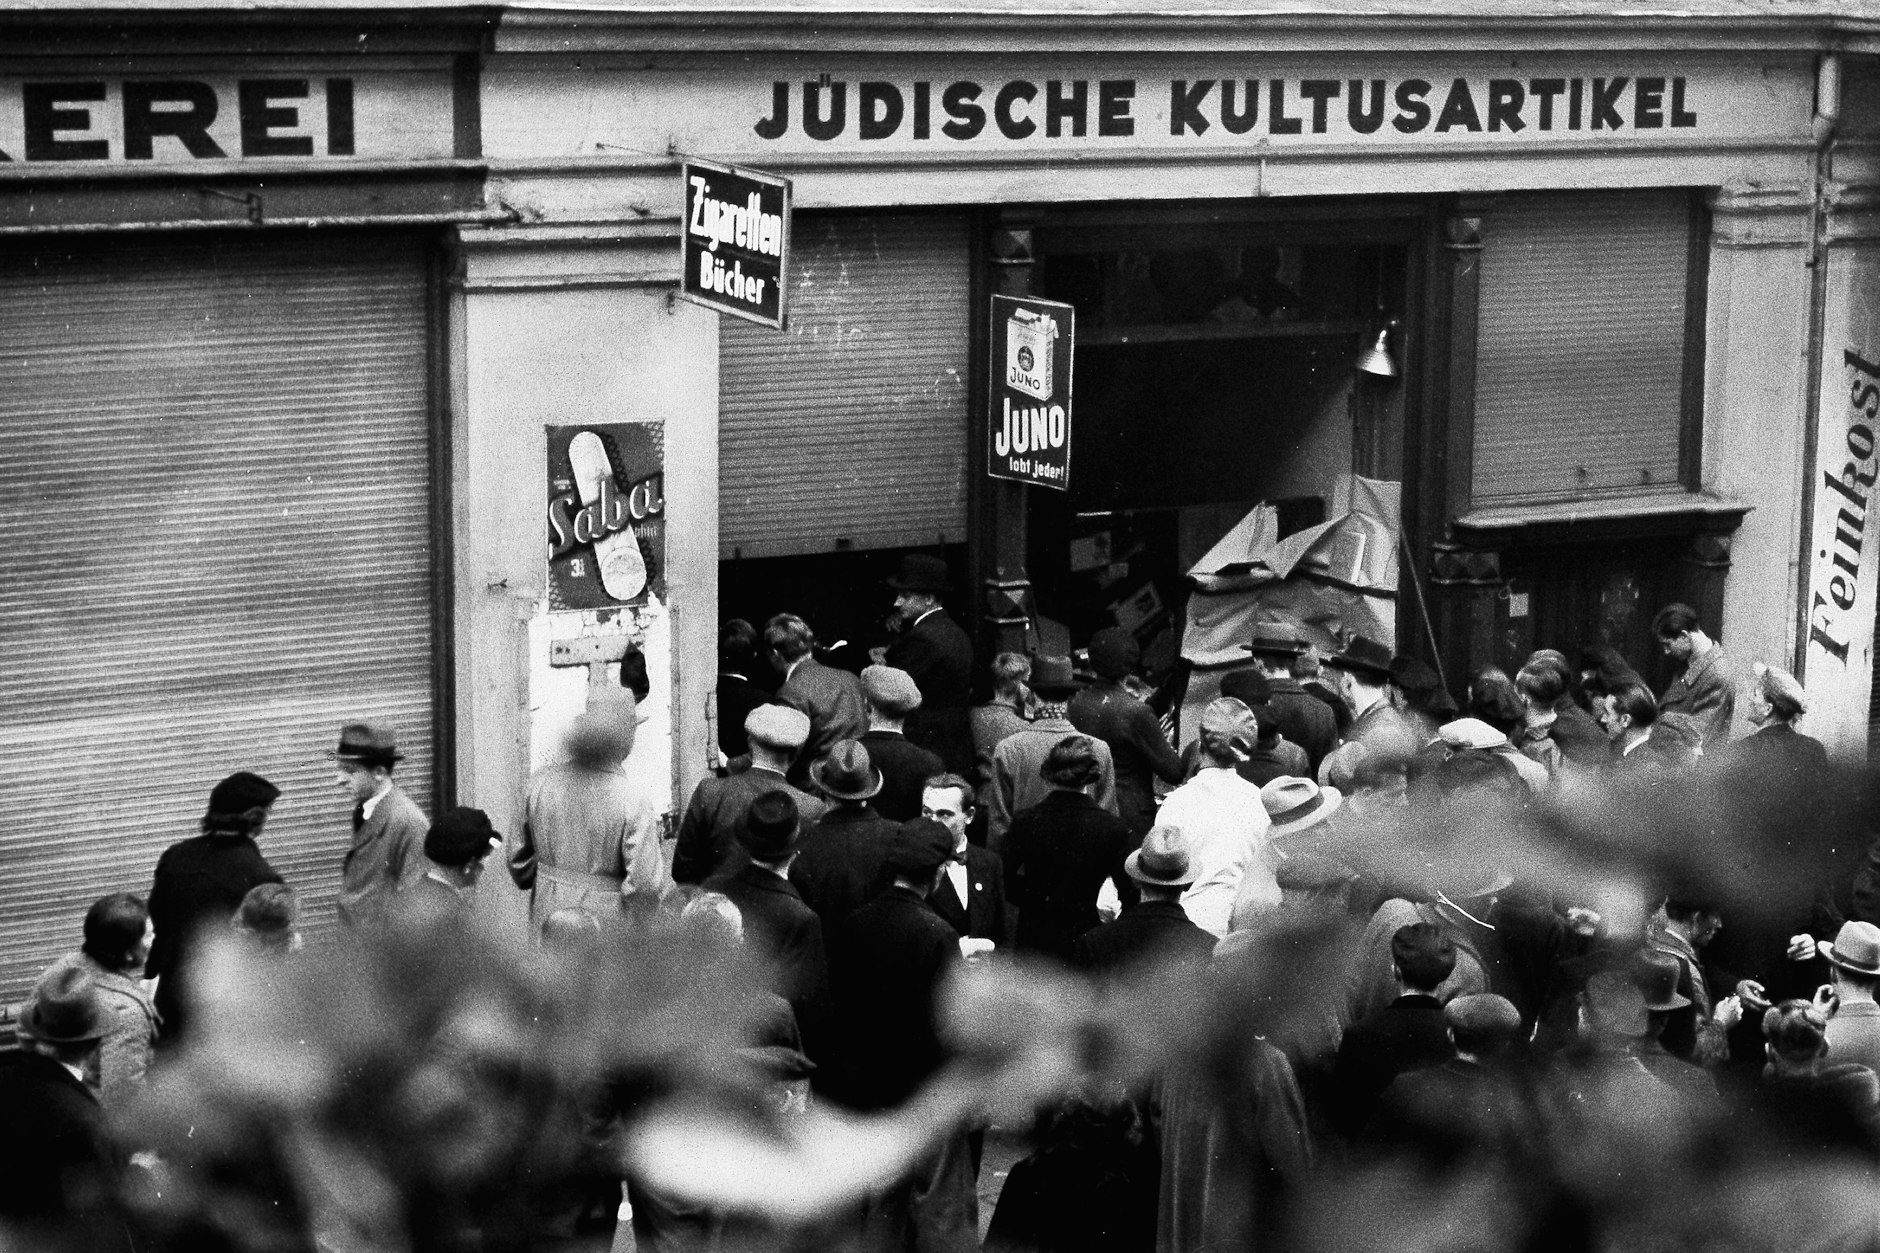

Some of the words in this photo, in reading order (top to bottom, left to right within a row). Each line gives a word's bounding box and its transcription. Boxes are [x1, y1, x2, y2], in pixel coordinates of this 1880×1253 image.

[0, 78, 355, 161] EREI
[754, 73, 1136, 141] JÜDISCHE
[1170, 77, 1698, 136] KULTUSARTIKEL
[690, 175, 781, 257] Zigaretten
[701, 250, 765, 304] Bücher
[1010, 366, 1040, 390] JUNO
[995, 397, 1065, 456] JUNO
[1009, 456, 1031, 473] lobt
[1032, 460, 1064, 480] jeder!
[1808, 347, 1880, 668] Feinkost
